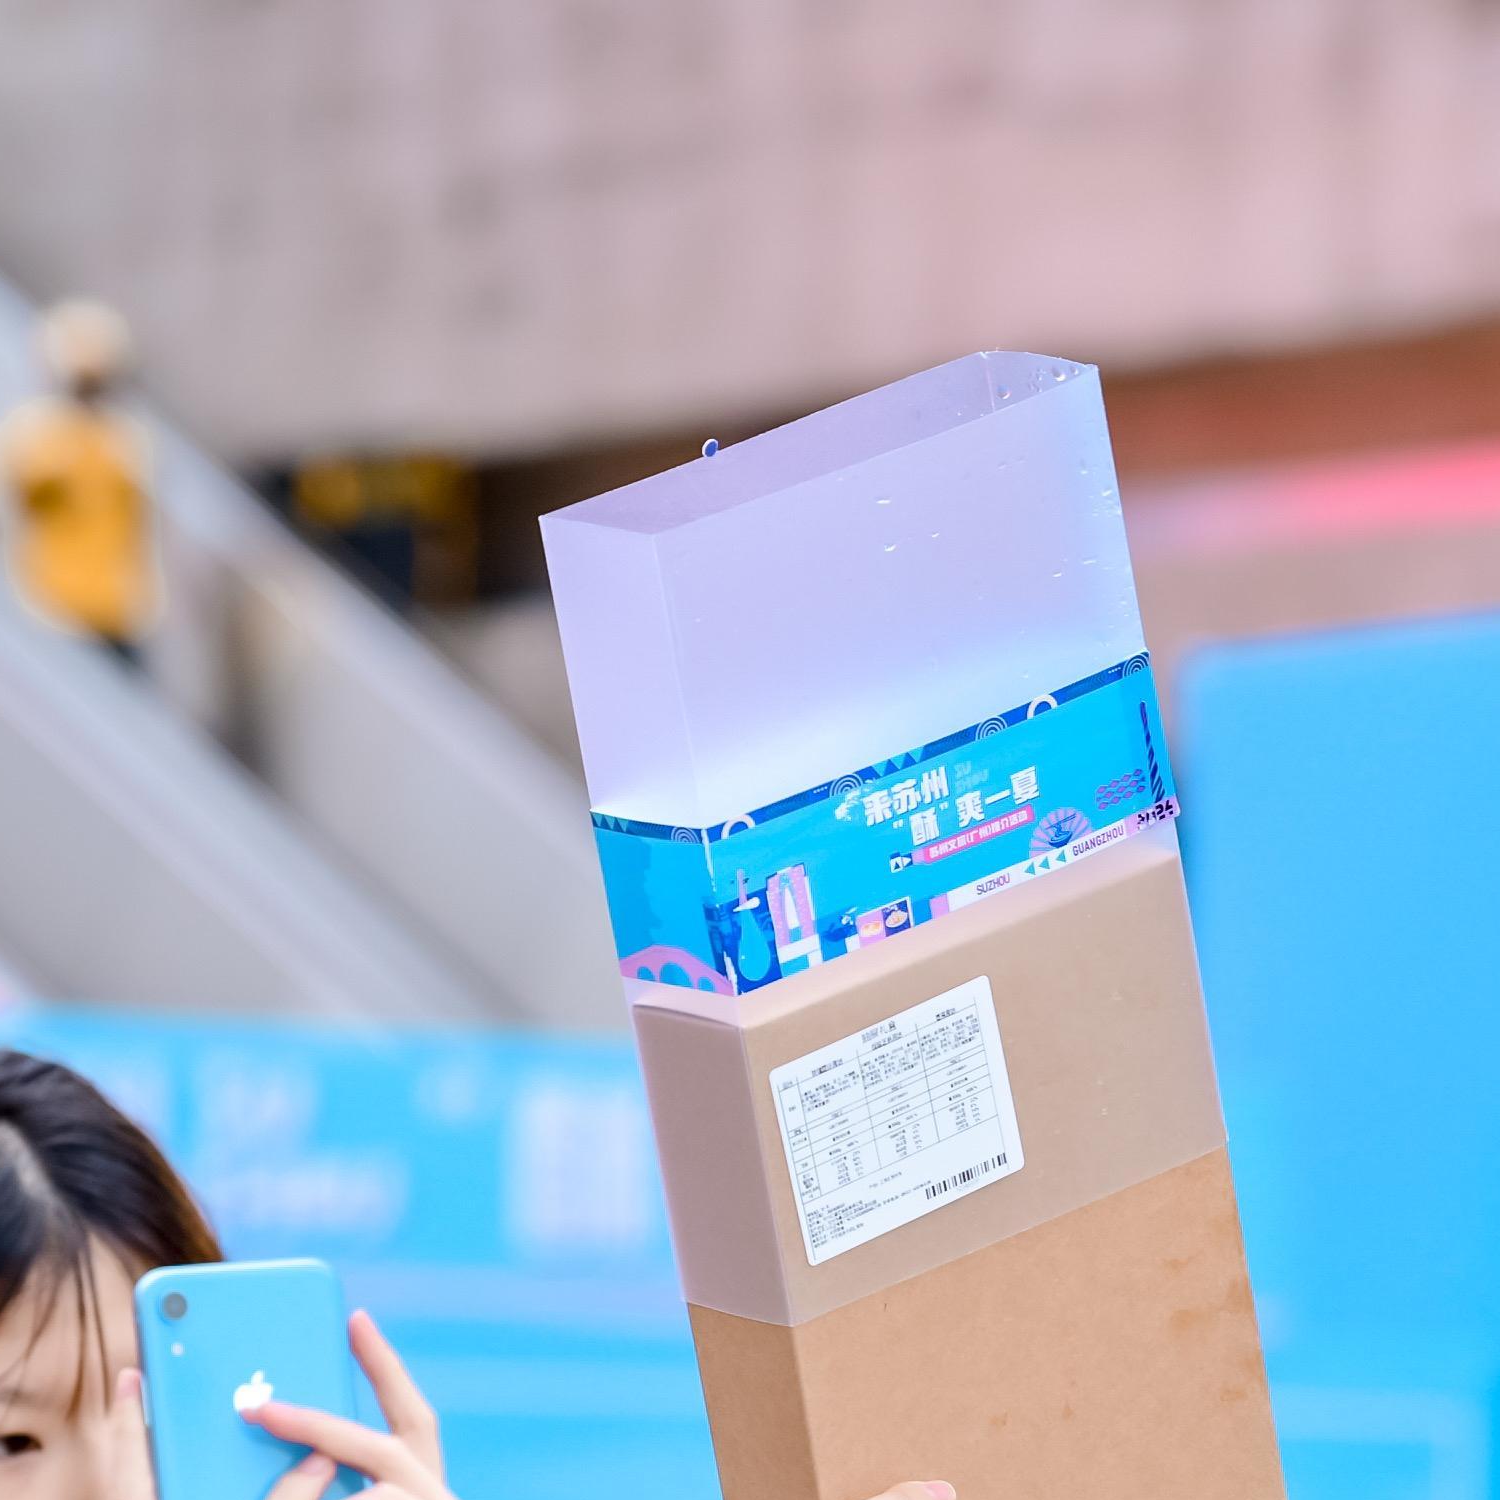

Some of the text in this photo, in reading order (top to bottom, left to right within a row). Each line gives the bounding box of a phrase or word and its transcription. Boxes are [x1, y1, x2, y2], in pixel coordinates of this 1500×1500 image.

[862, 765, 951, 828] 来苏州
[976, 824, 1125, 896] SUZHOU GUANGZHOU
